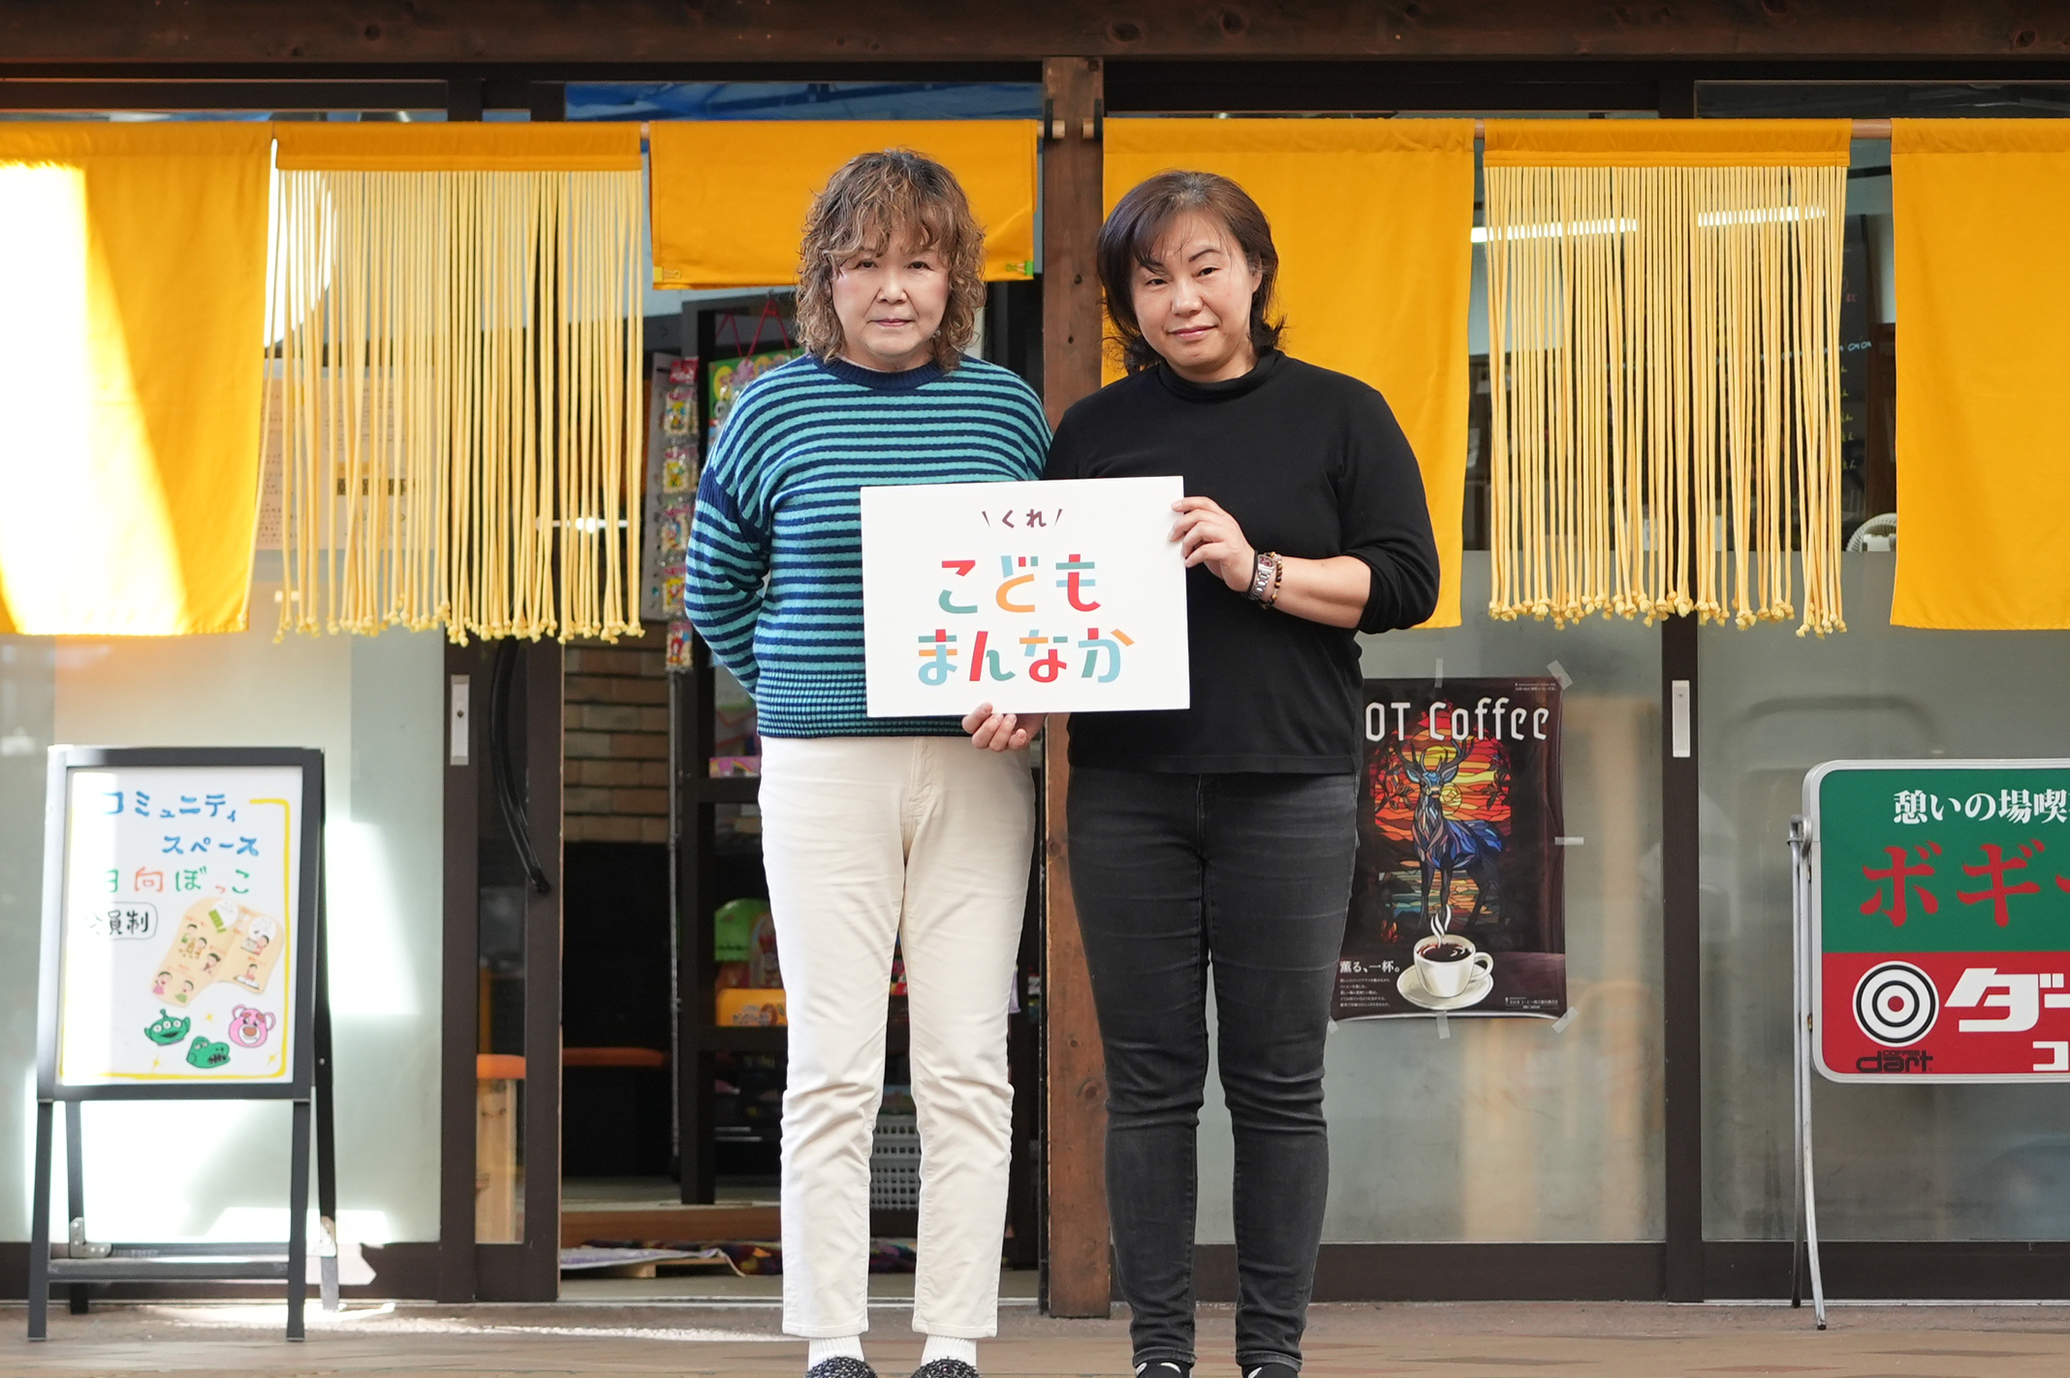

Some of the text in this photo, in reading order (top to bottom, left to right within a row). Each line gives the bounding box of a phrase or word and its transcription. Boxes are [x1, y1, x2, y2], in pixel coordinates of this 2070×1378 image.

[1000, 508, 1048, 529] くれ
[938, 553, 1102, 614] こども
[917, 627, 1135, 686] まんなか
[1364, 697, 1551, 742] OT Coffee
[101, 790, 237, 823] コミュニティ
[1893, 788, 2070, 825] 憩いの場喫
[161, 835, 260, 857] スペース
[1859, 838, 2070, 928] ボギ
[1339, 960, 1401, 974] 薫る、一杯。
[1855, 1050, 1934, 1073] dart
